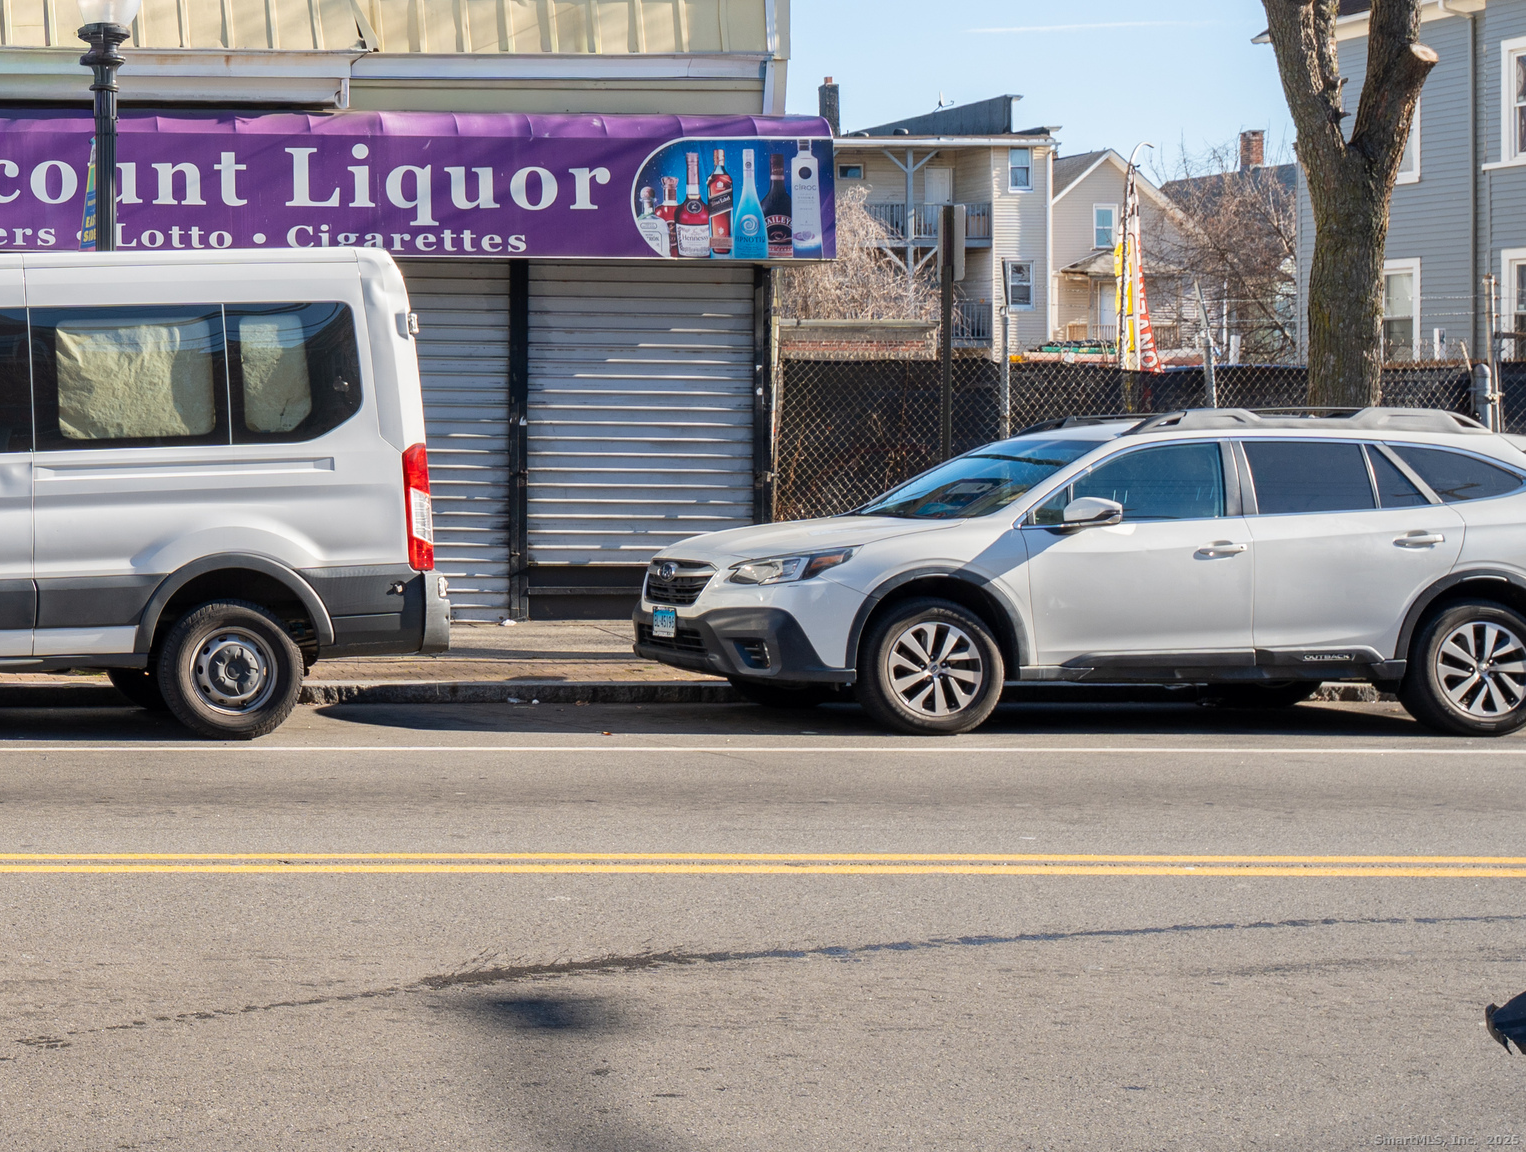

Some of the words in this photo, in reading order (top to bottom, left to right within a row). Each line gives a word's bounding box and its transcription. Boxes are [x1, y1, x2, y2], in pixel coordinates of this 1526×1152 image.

[284, 143, 611, 226] Liquor
[116, 223, 233, 249] Lotto
[286, 224, 527, 252] Cigarettes
[682, 234, 709, 242] Hennessy
